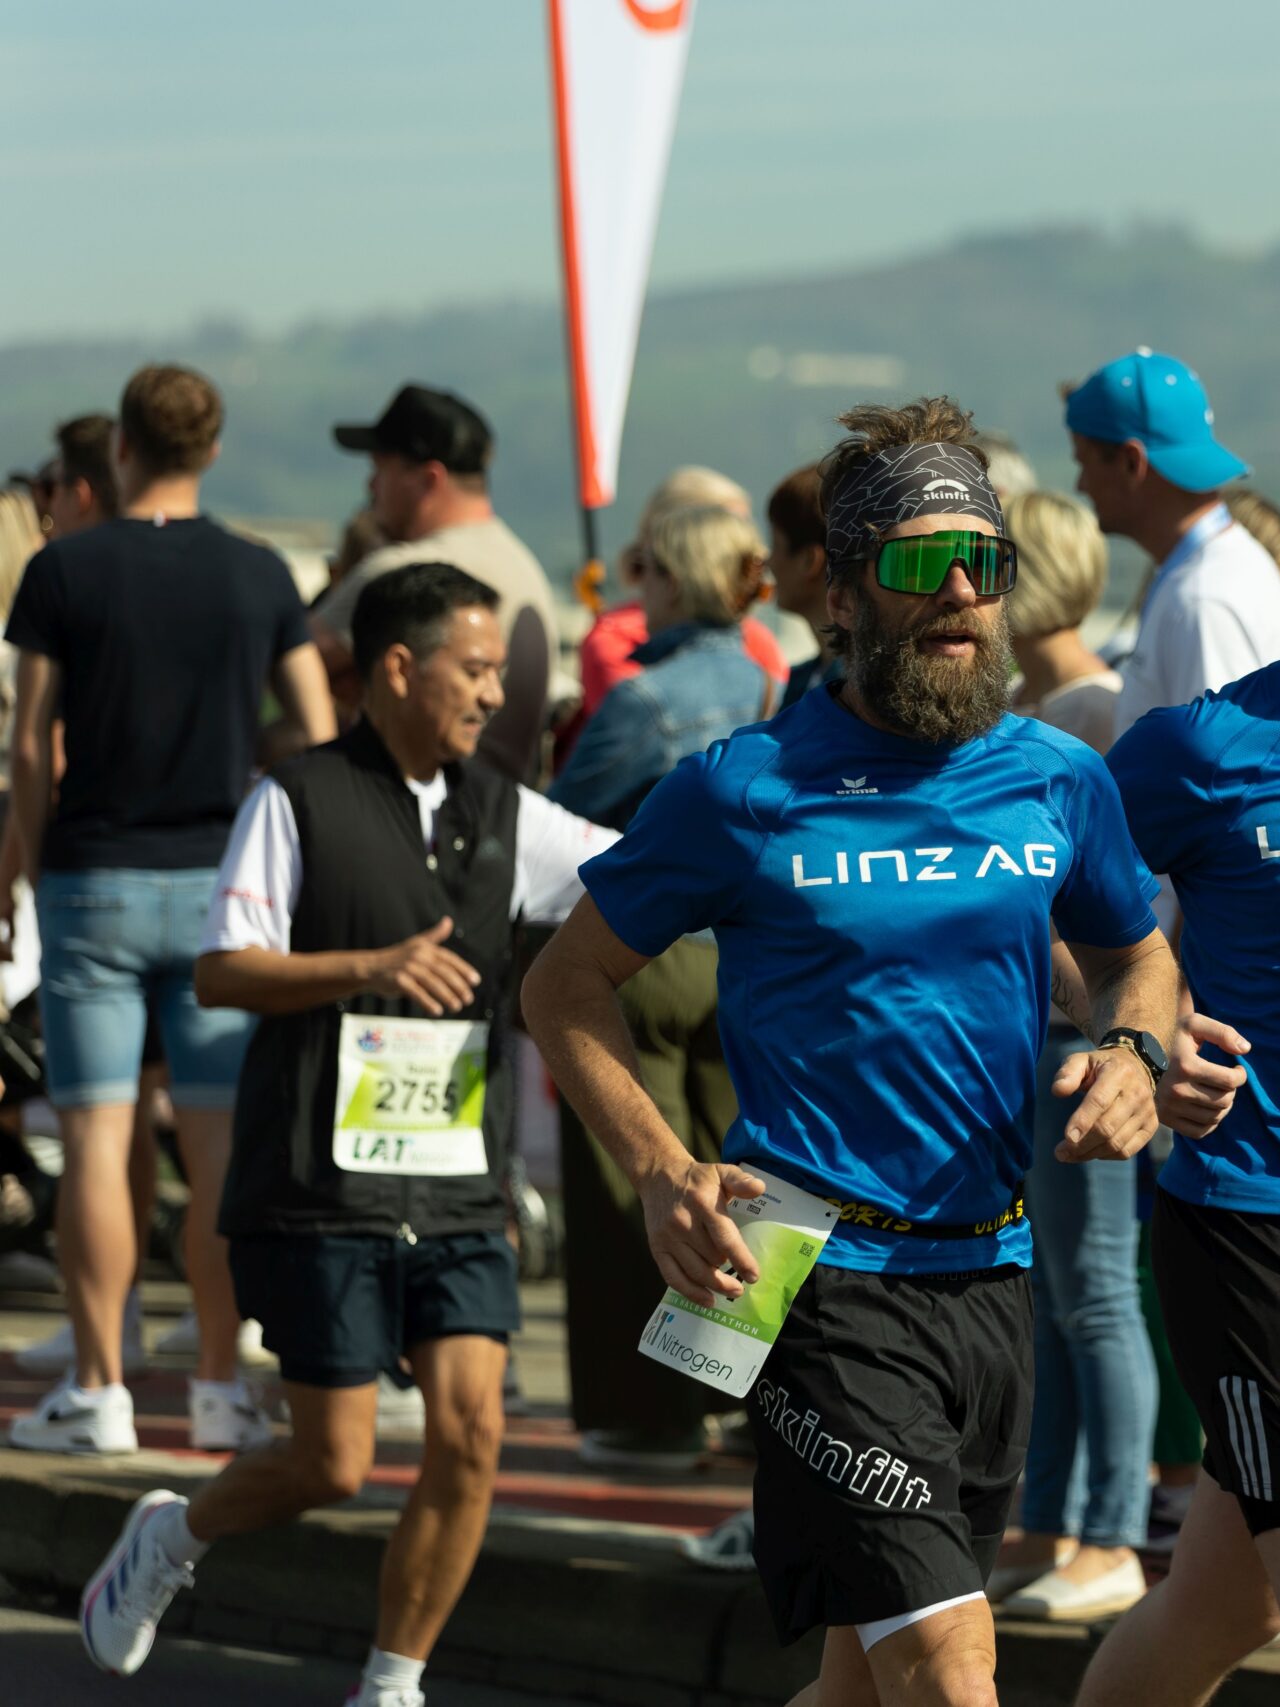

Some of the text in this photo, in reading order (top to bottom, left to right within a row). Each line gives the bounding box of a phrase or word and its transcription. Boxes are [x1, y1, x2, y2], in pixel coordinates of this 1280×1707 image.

[923, 490, 971, 501] skinfit
[836, 787, 879, 795] erima
[975, 843, 1057, 878] AG
[352, 1135, 407, 1162] LAT
[658, 1333, 734, 1381] Nitrogen
[756, 1378, 932, 1511] skinfit
